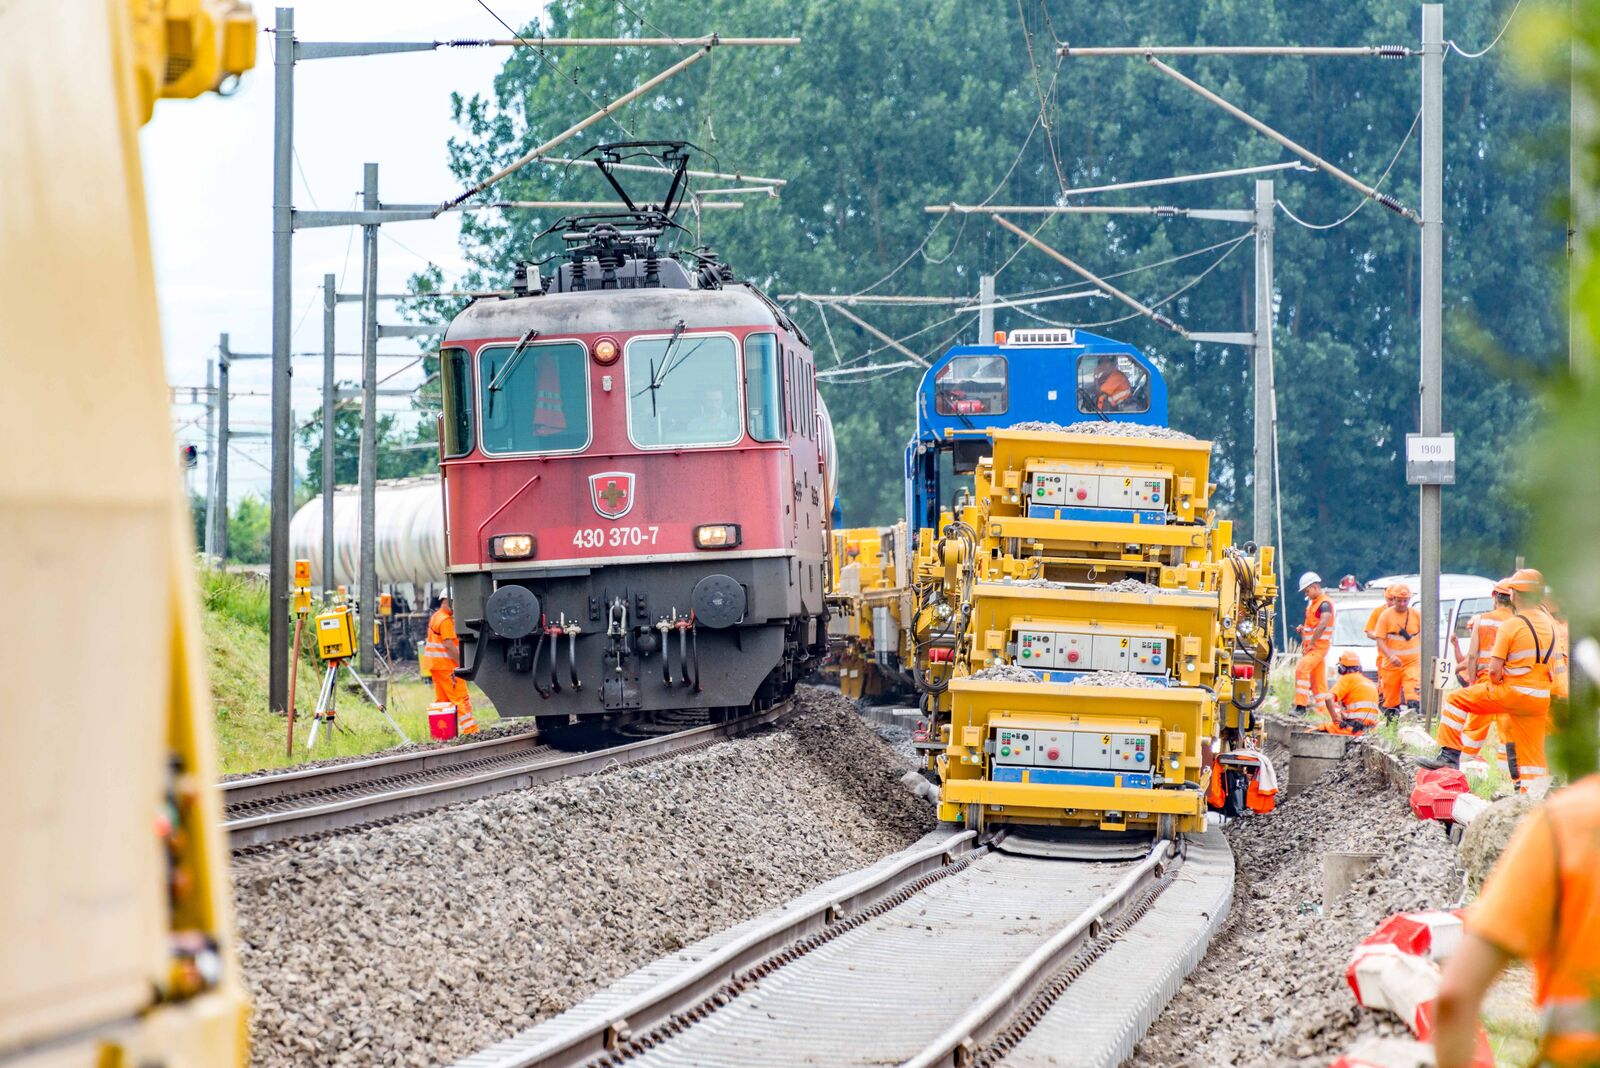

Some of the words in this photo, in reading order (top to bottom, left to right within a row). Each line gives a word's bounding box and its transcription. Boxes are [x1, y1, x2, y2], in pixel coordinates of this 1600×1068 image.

[1421, 445, 1441, 454] 1900
[573, 528, 604, 548] 430
[609, 526, 659, 547] 370-7
[1440, 661, 1451, 674] 31
[1441, 676, 1449, 689] 7
